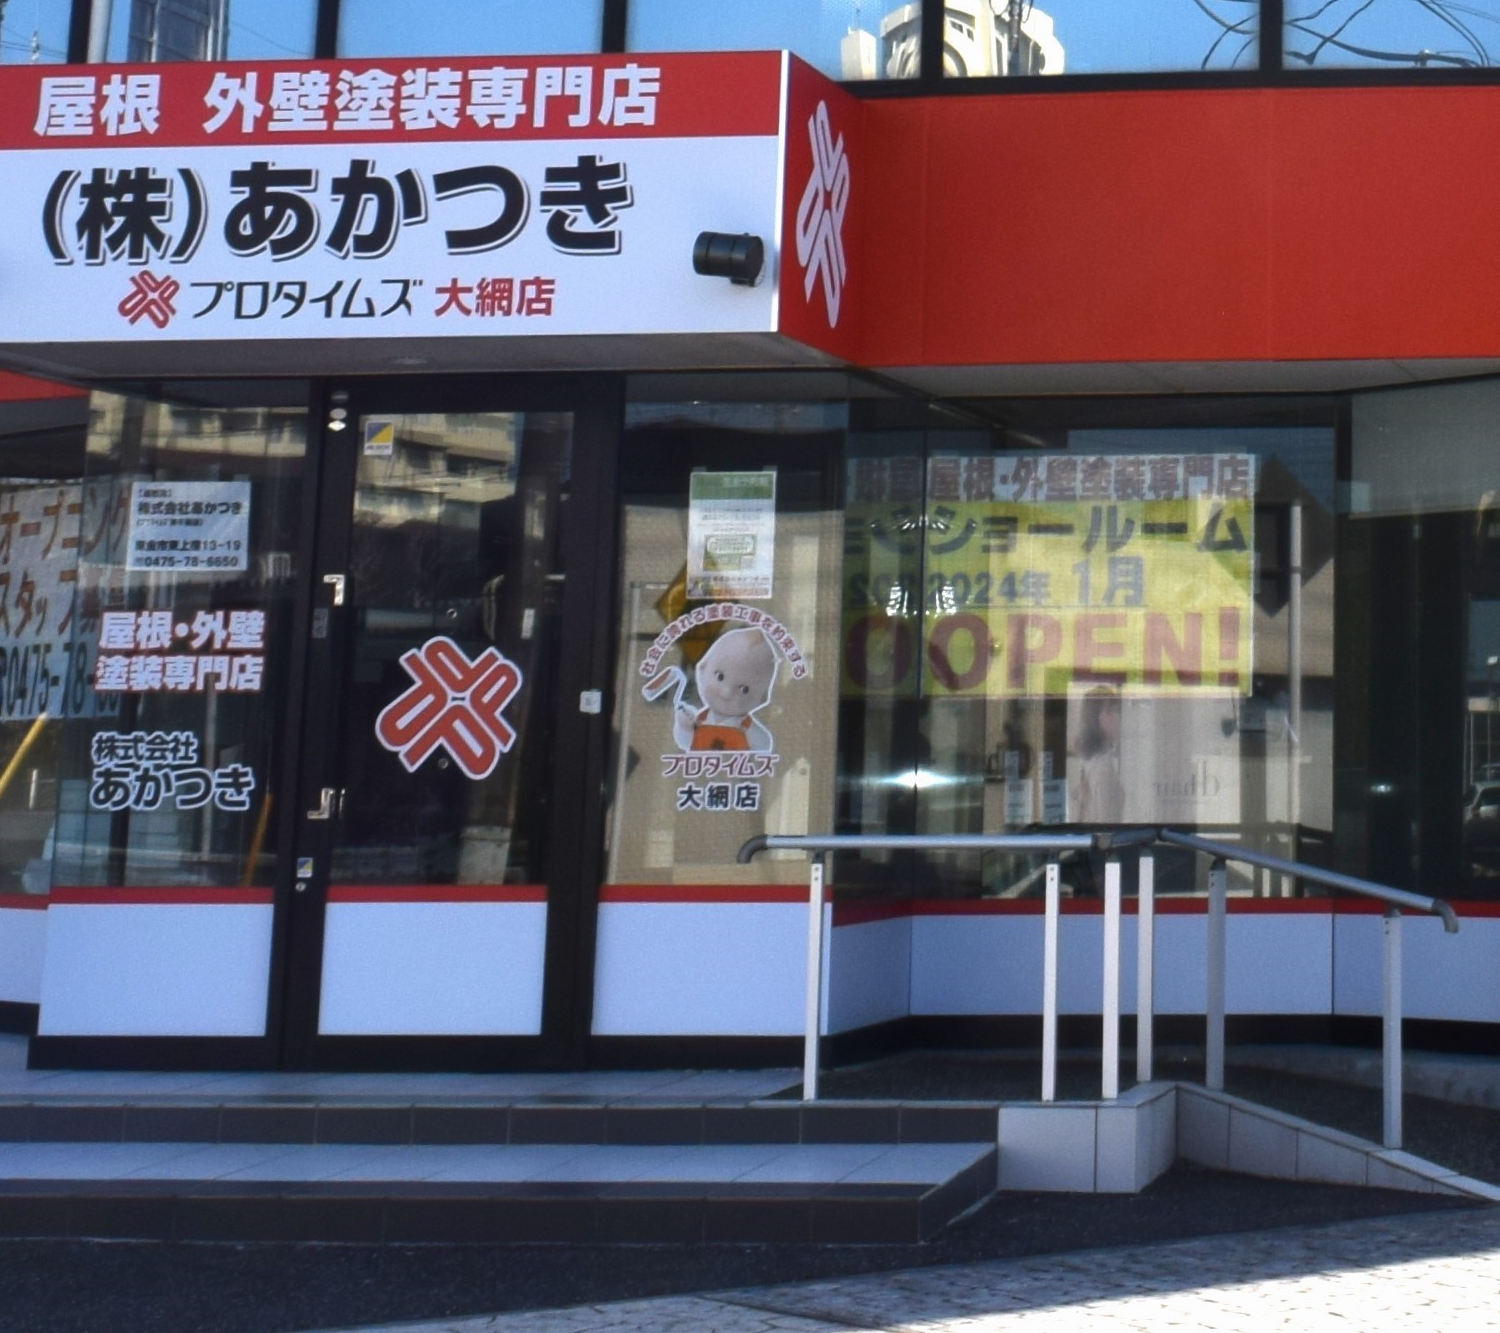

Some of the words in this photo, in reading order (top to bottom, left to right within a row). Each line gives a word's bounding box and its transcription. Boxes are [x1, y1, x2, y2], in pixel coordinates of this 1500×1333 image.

[33, 73, 161, 138] 屋根
[202, 63, 663, 134] 外壁塗装専門店
[190, 278, 424, 322] プロタイムズ
[434, 275, 556, 318] 大網店
[930, 504, 1248, 555] ショールーム
[1072, 557, 1146, 608] 1月
[100, 611, 266, 651] 屋根・外壁
[640, 603, 809, 680] 社会に誇れる塗装工事を約束する
[95, 654, 265, 692] 塗装専門店
[92, 732, 198, 764] 株式会社
[661, 753, 780, 779] プロタイムズ
[91, 764, 255, 813] あかつき
[676, 782, 761, 812] 大網店
